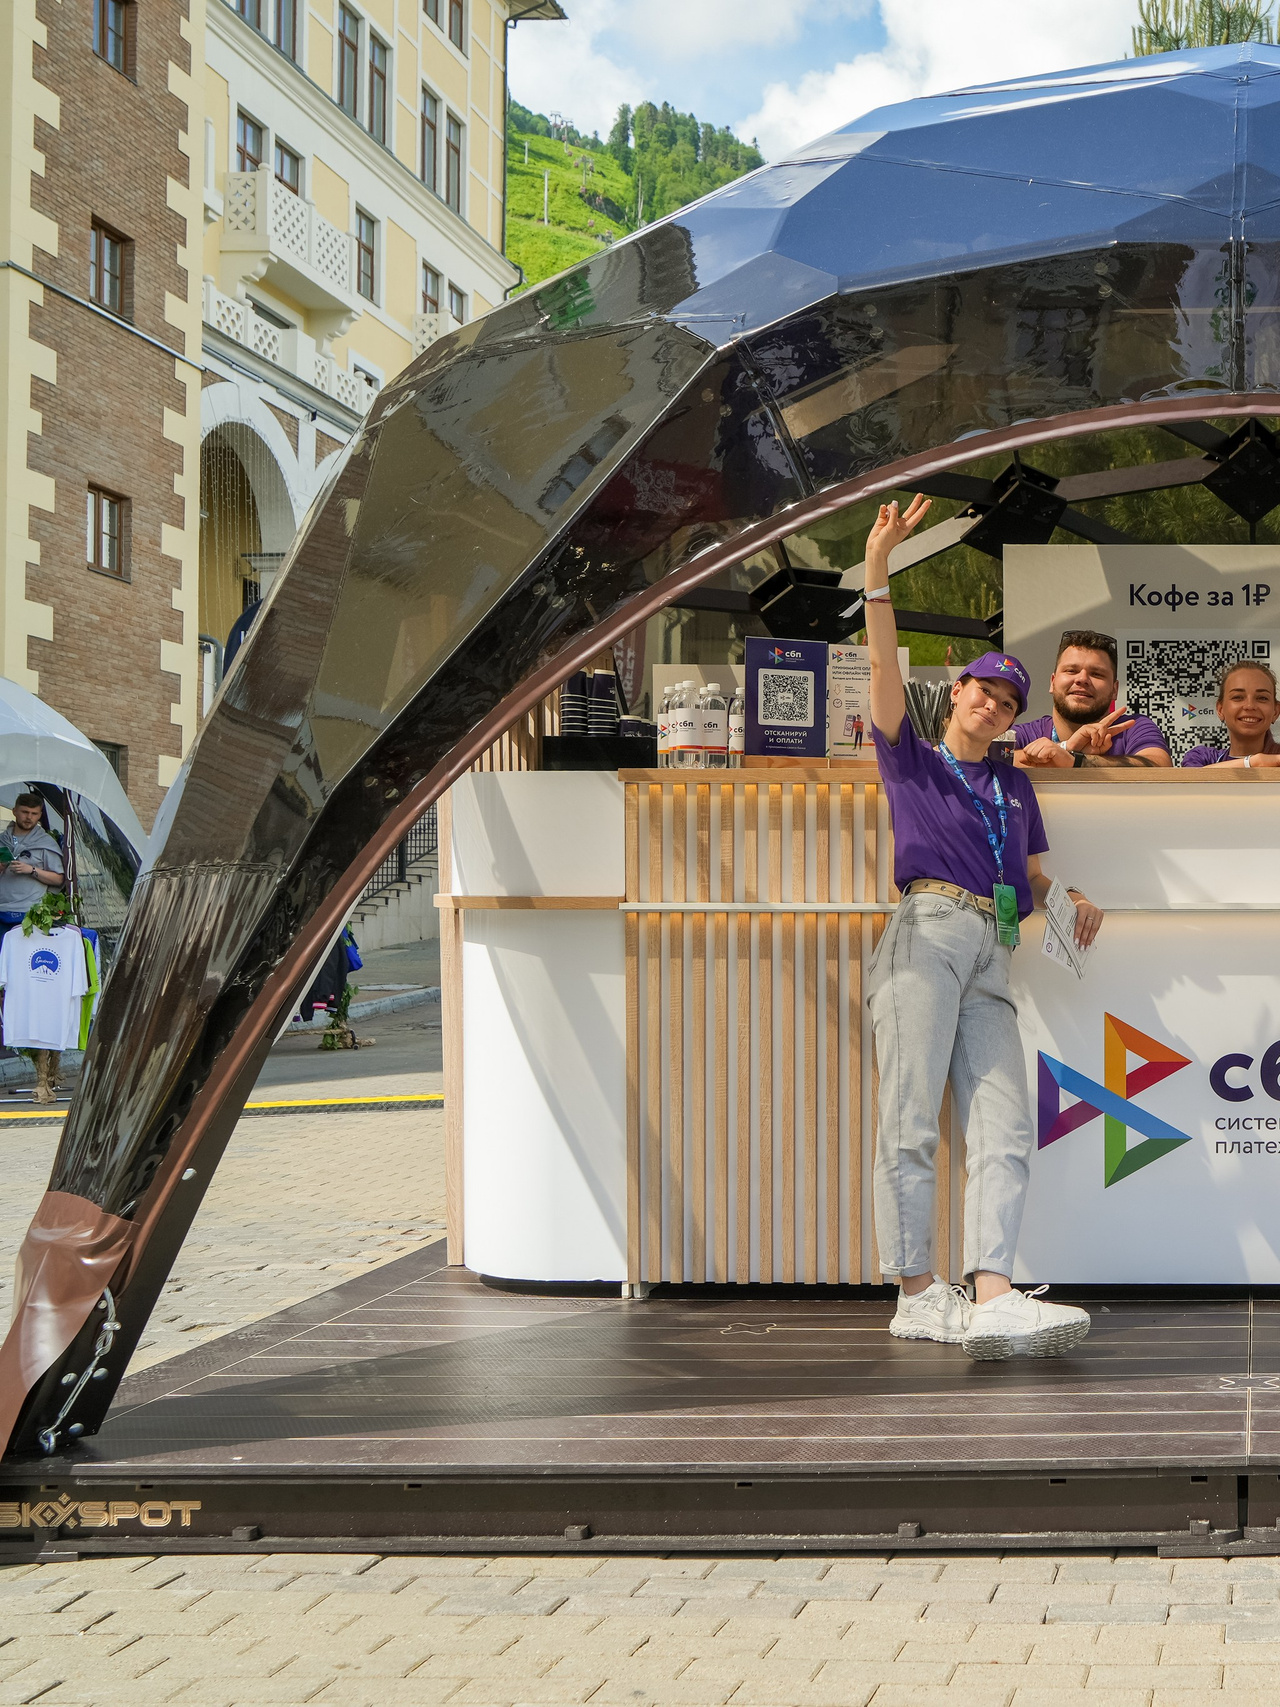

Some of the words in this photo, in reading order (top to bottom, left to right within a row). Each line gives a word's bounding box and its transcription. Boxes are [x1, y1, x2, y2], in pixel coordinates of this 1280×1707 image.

[1129, 583, 1199, 612] Кофе
[1207, 588, 1234, 607] за
[0, 1498, 201, 1528] SKYSPOT
